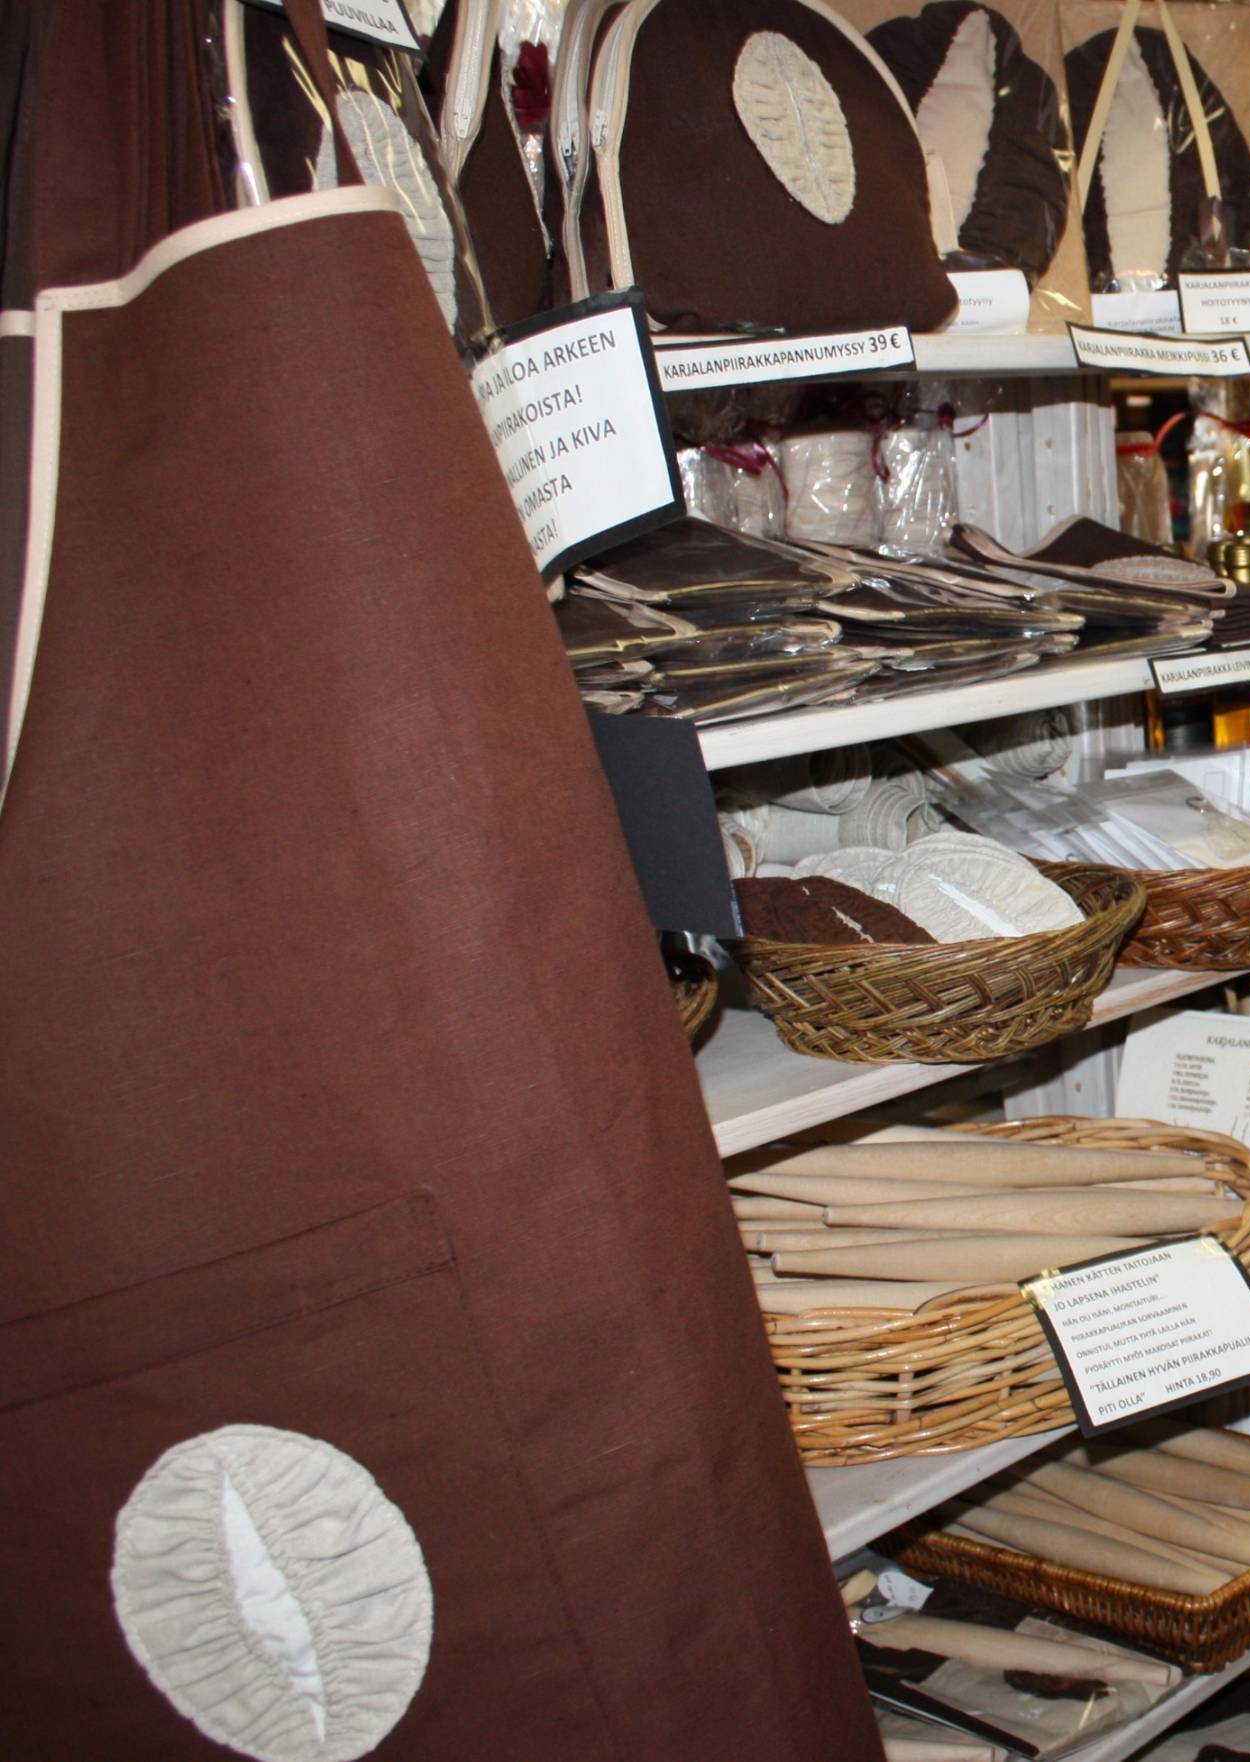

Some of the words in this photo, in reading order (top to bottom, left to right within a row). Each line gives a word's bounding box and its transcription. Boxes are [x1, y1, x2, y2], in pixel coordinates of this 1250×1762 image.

[543, 330, 616, 372] ARKEEN
[663, 342, 866, 380] KARJALANPIIRAKKAPANNUMYSSY
[869, 335, 888, 354] 39
[890, 332, 902, 350] €
[1211, 349, 1228, 363] 36
[1231, 348, 1241, 361] €
[549, 437, 570, 460] JA
[571, 418, 617, 449] KIVA
[1122, 1251, 1172, 1271] TAITOJAAN
[1053, 1301, 1067, 1312] JO
[1066, 1289, 1110, 1308] LAPSENA
[1112, 1334, 1140, 1347] MUTTA
[1122, 1349, 1145, 1362] MYÖS
[1097, 1402, 1118, 1417] PITI
[1164, 1377, 1196, 1395] HINTA
[1195, 1367, 1223, 1386] 18,90
